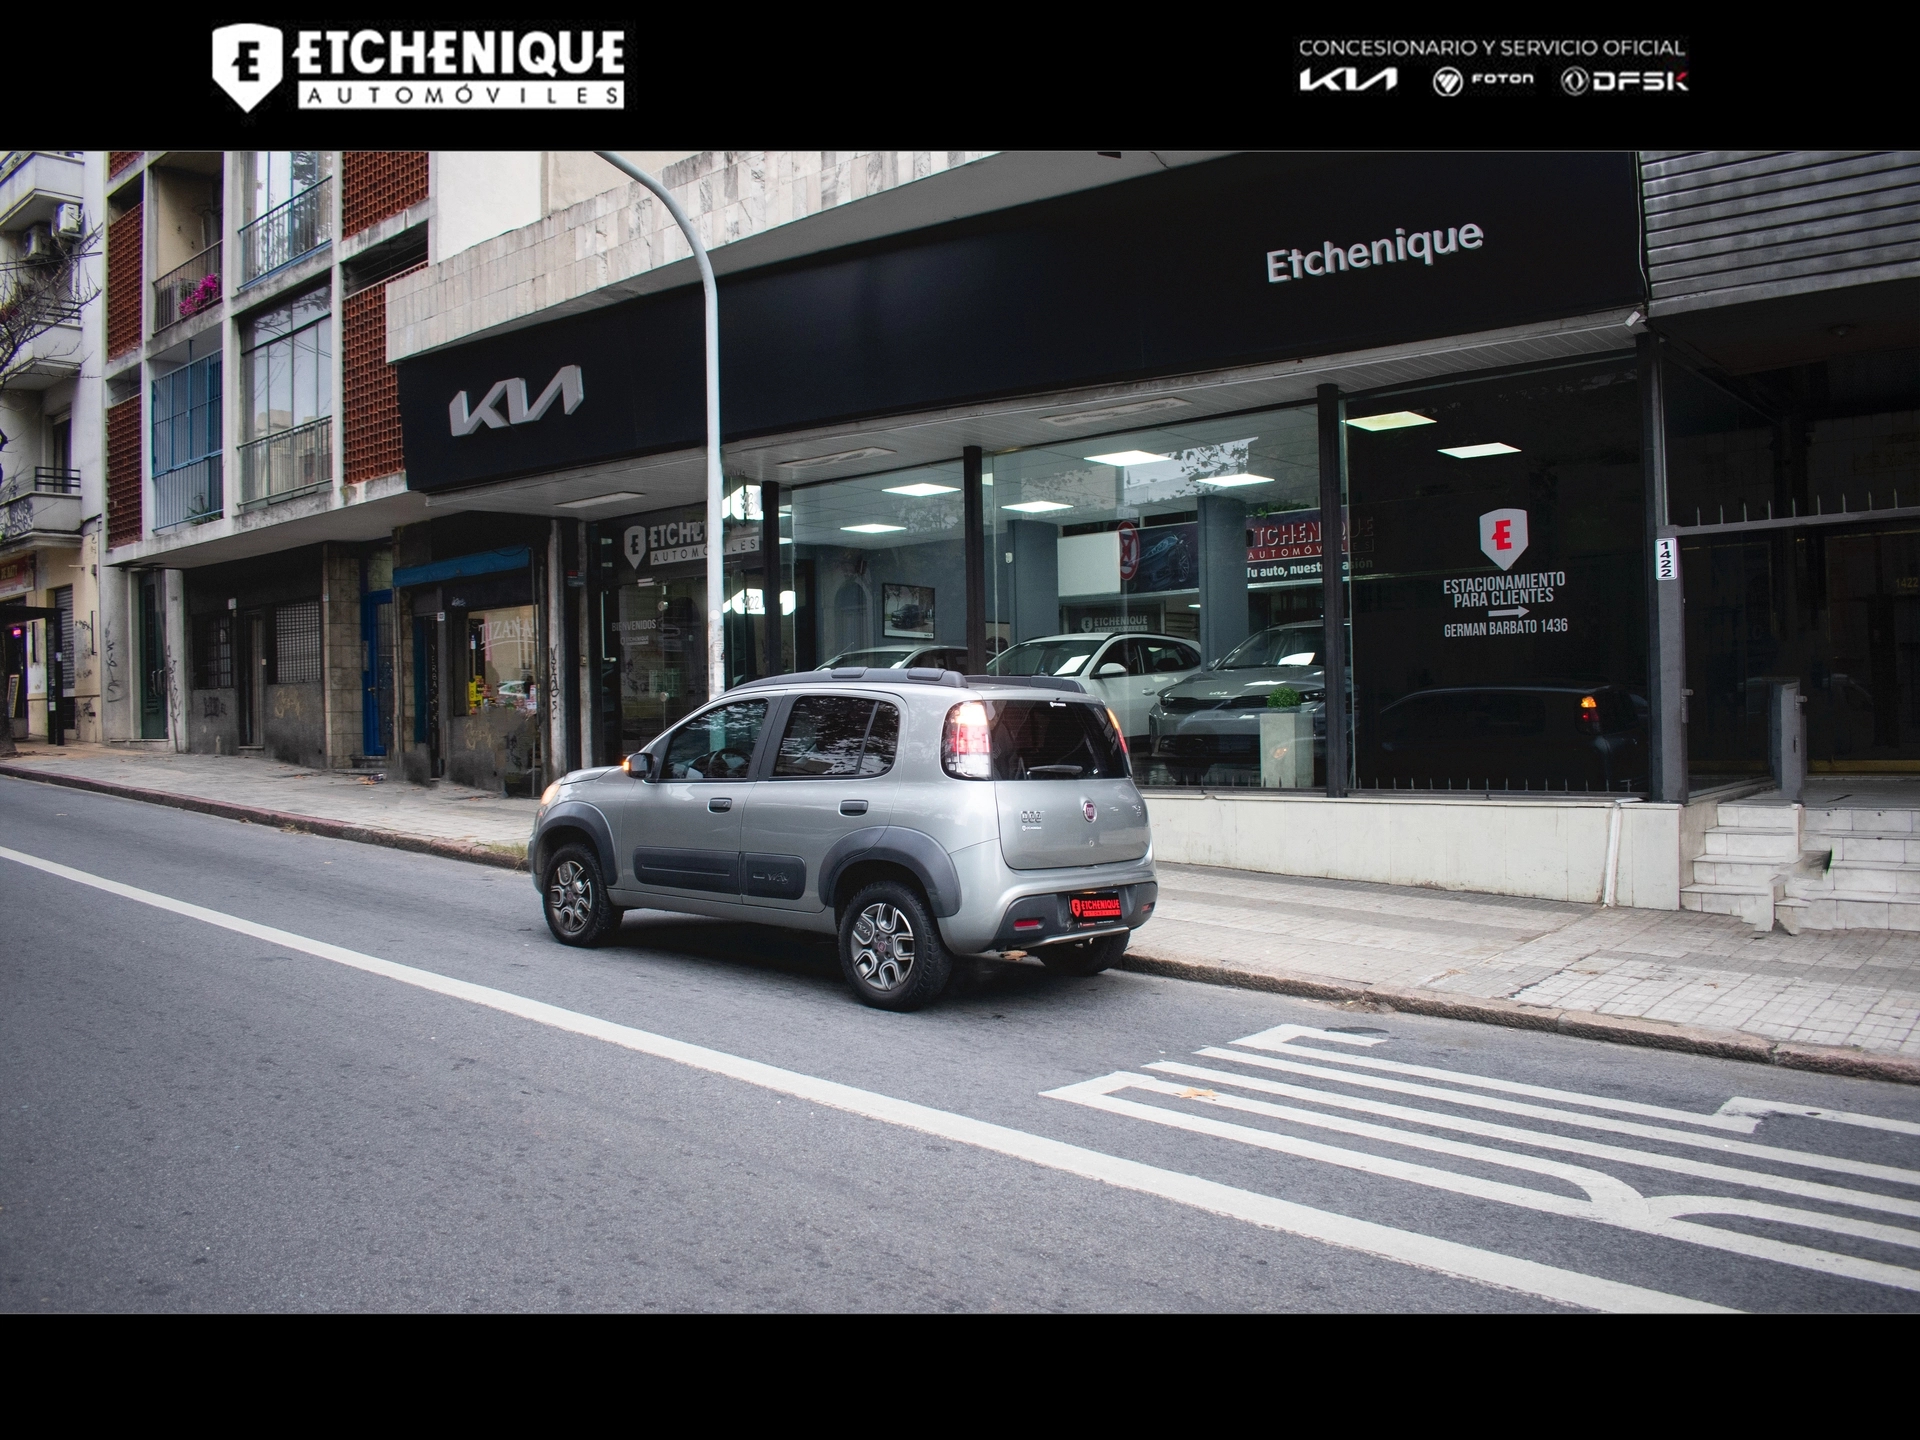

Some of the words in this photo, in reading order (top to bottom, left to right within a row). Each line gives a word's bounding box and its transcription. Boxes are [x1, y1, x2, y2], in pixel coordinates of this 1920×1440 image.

[1266, 222, 1484, 283] Etchenique
[448, 364, 584, 437] KIA
[1341, 557, 1373, 571] asión
[1659, 541, 1672, 578] 1422
[1443, 571, 1566, 594] ESTACIONAMIENTO
[1454, 592, 1488, 608] PARA
[1491, 587, 1554, 606] CLIENTES
[478, 617, 534, 645] TIZANA
[611, 619, 657, 632] BIENVENIDOS
[1094, 615, 1148, 627] ETCHENIQUE
[1444, 622, 1487, 638] GERMAN
[1489, 619, 1537, 635] BARBATO
[1541, 618, 1568, 633] 1436
[1081, 899, 1120, 910] ETCHENIQUE
